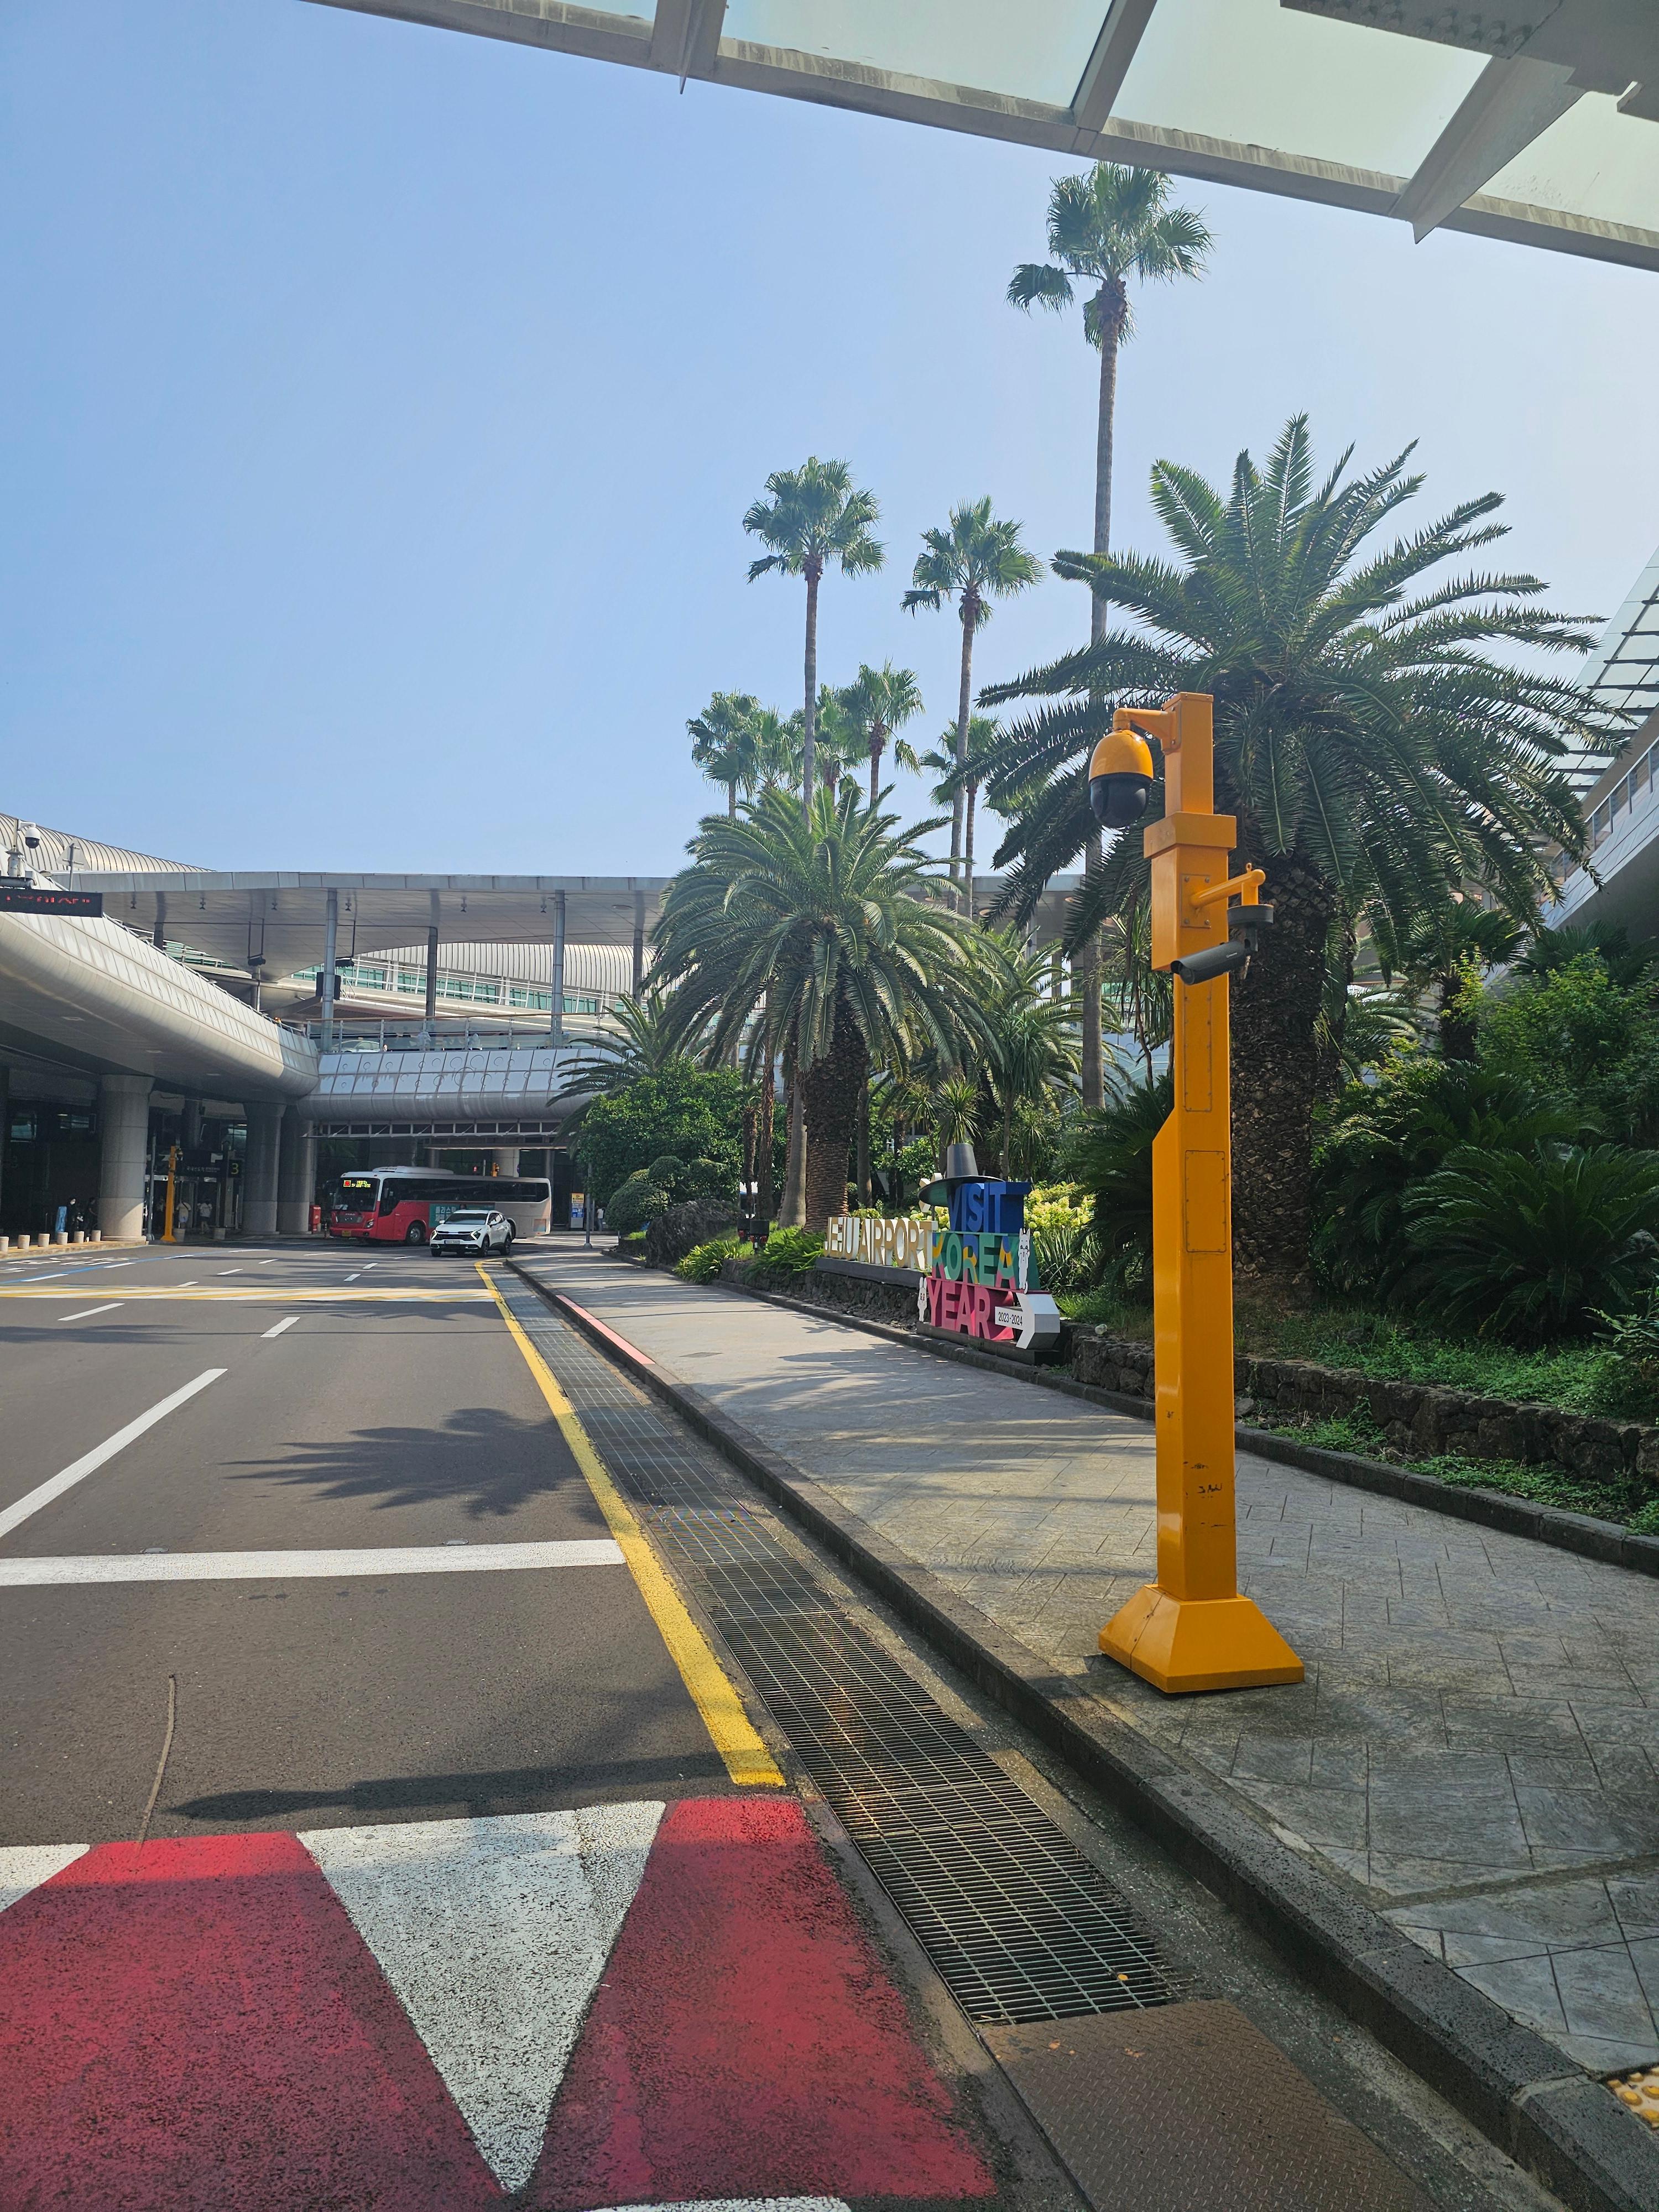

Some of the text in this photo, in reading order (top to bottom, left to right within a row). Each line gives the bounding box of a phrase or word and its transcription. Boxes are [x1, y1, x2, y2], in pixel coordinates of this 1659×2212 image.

[231, 1163, 239, 1175] 3
[947, 1182, 1007, 1233] VISIT
[823, 1217, 936, 1270] JEJU AIRPORT
[932, 1233, 1018, 1290] KOREA
[927, 1278, 992, 1340] YEAR
[998, 1311, 1022, 1326] 2023-2024
